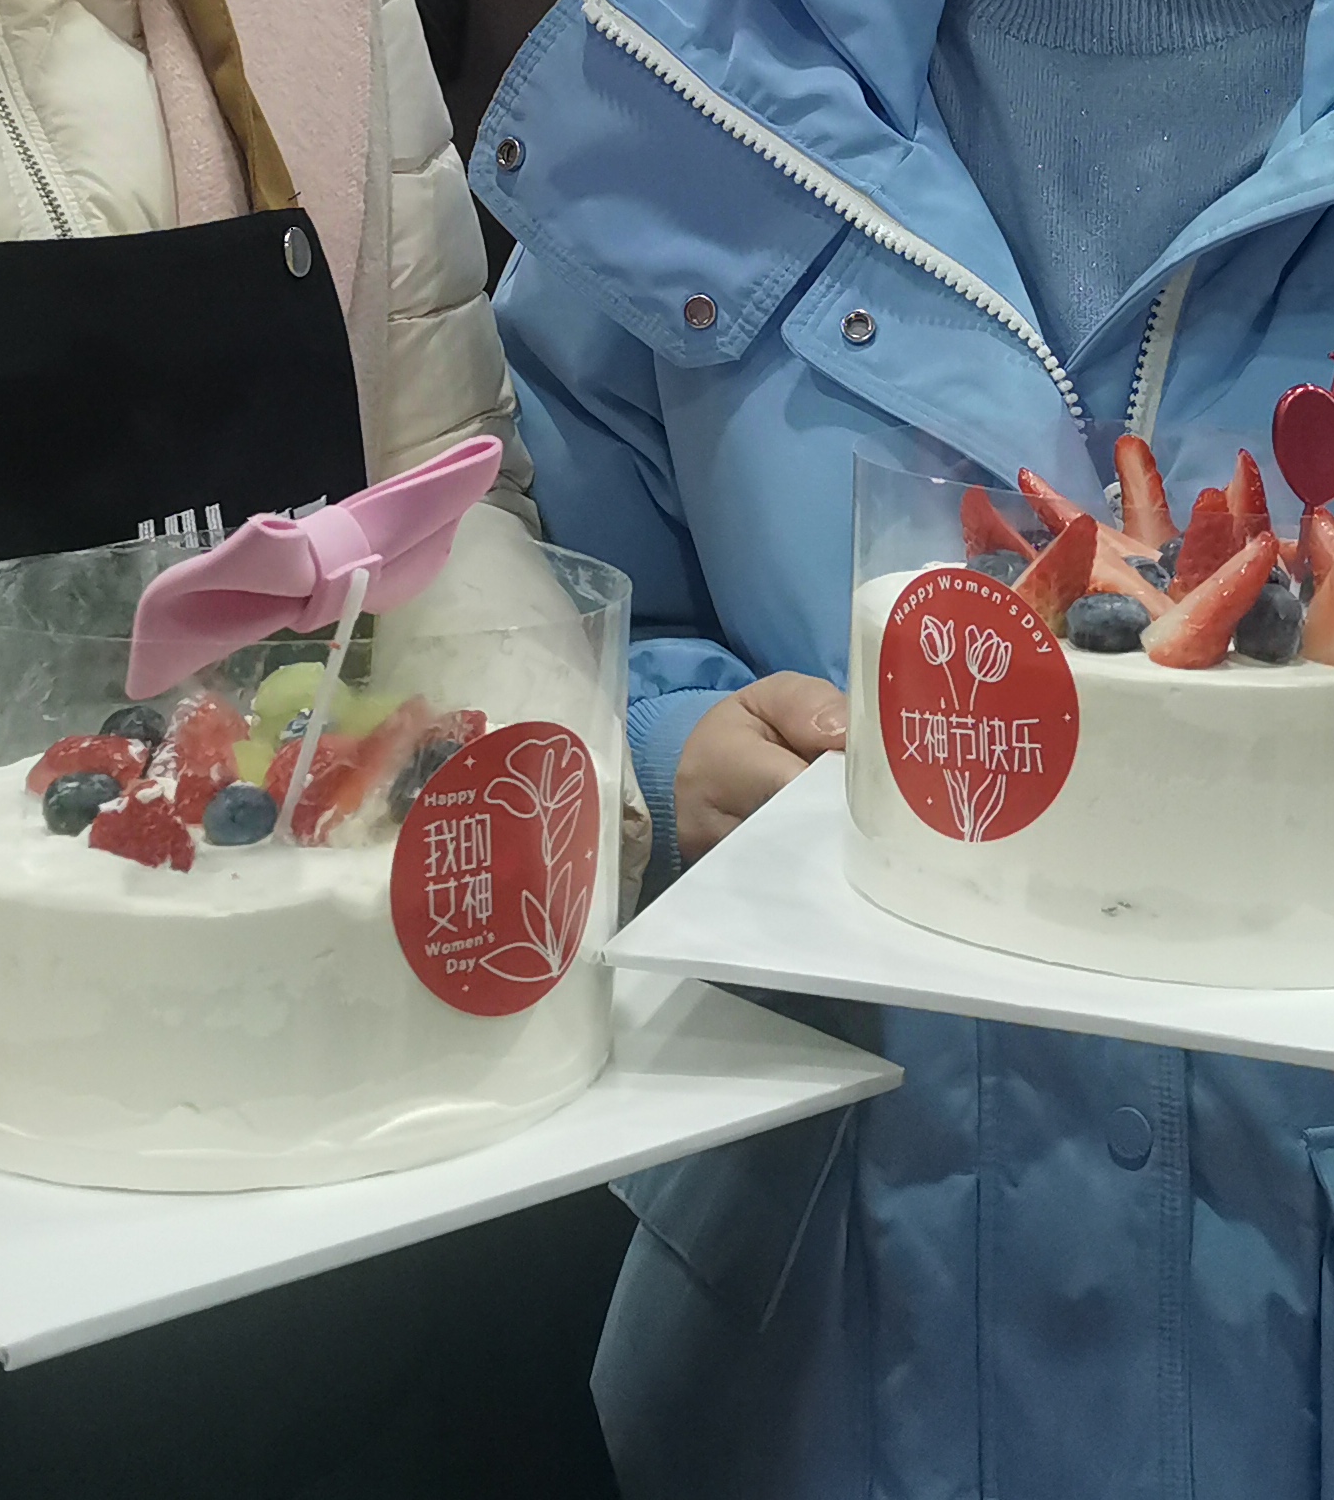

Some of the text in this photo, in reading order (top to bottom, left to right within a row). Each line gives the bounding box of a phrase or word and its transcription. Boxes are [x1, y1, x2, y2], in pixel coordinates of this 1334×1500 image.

[893, 575, 1053, 654] Happy Women's Day
[900, 706, 1044, 774] 女神节快乐
[424, 788, 478, 808] Happy
[422, 812, 492, 878] 我的
[423, 870, 493, 938] 女神
[424, 930, 496, 958] Women's
[446, 956, 477, 974] Day
